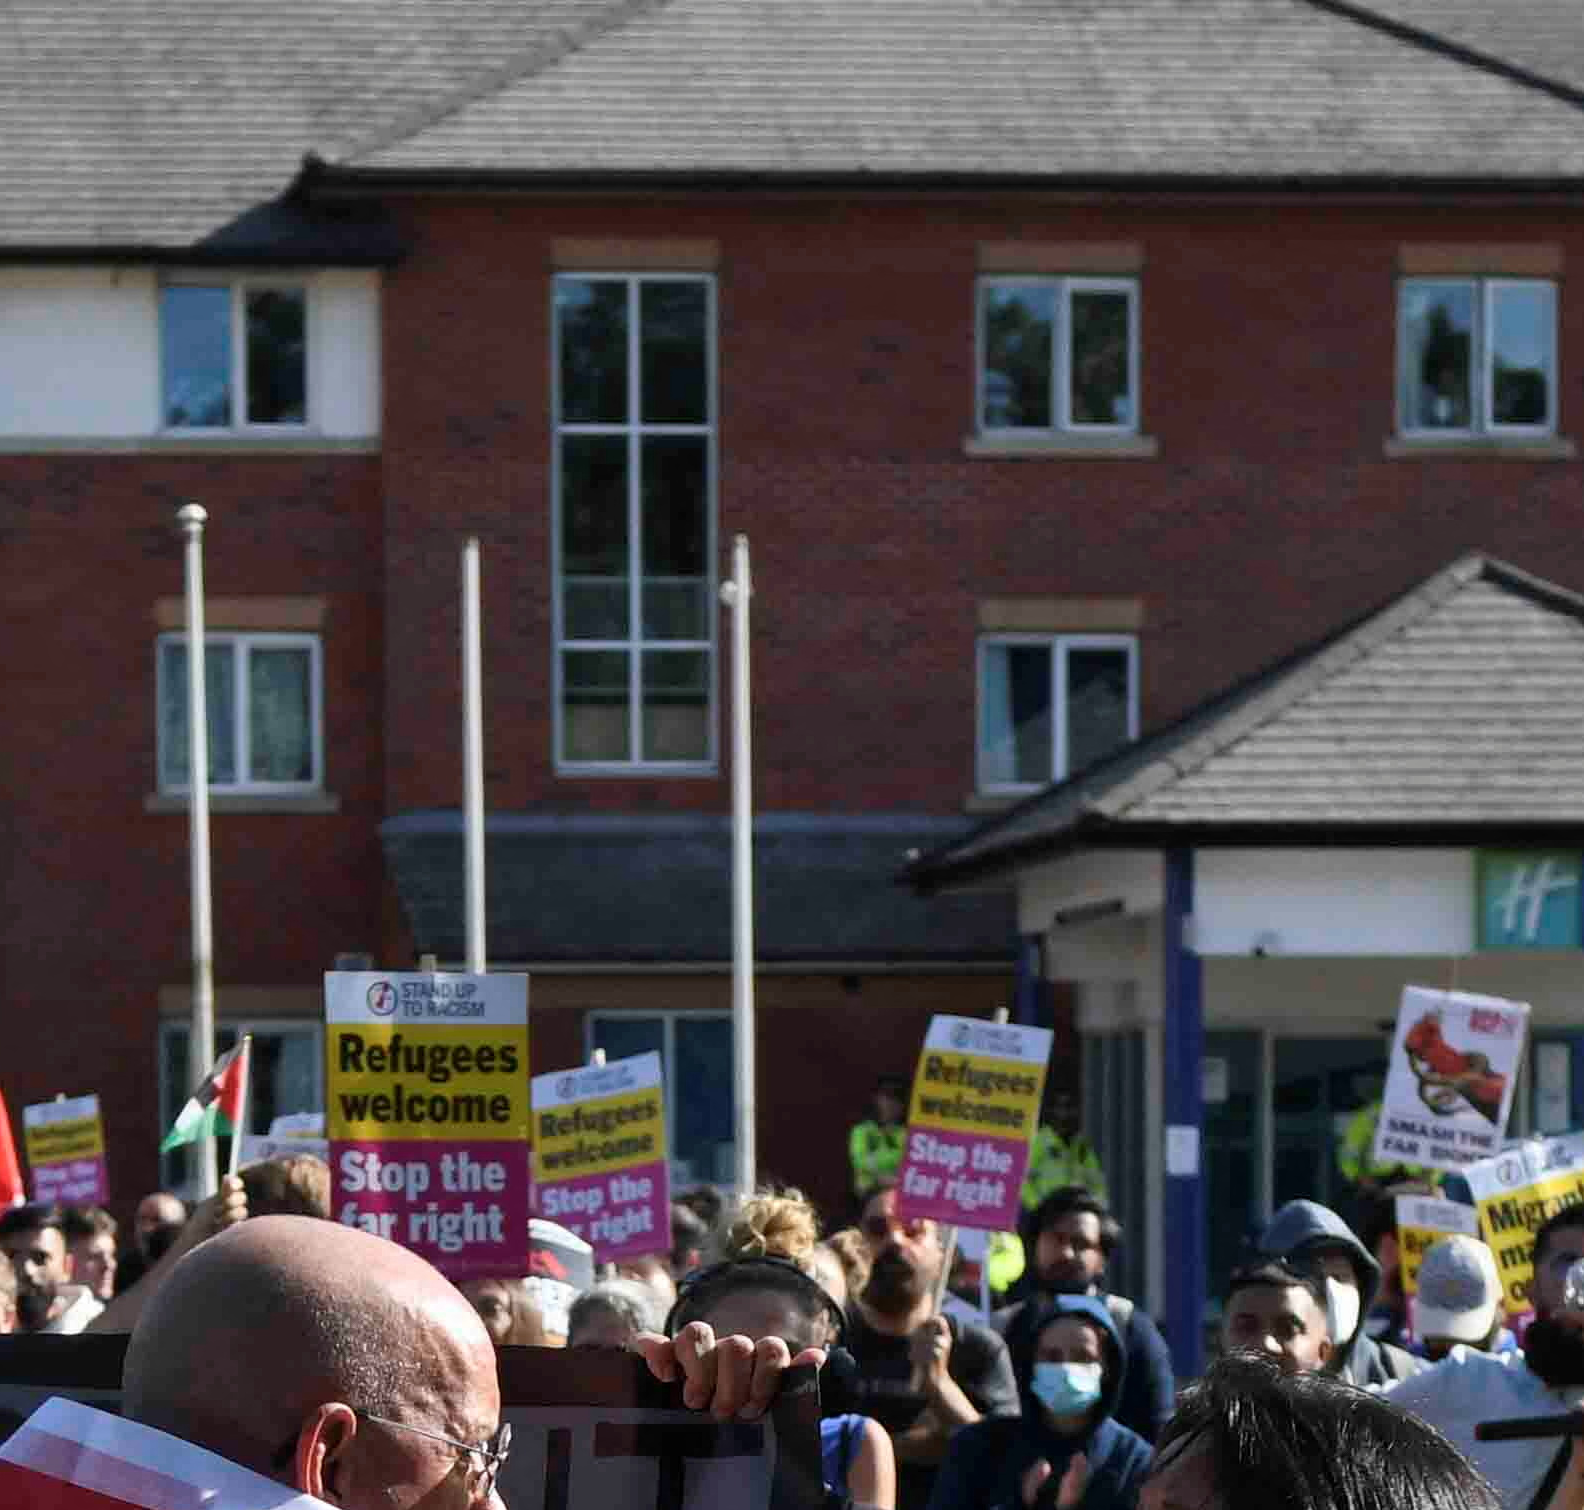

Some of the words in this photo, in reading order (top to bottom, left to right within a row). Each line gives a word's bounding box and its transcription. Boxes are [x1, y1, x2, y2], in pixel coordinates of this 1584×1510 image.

[401, 981, 452, 1000] STAND
[456, 983, 477, 1001] UP
[402, 1001, 424, 1016] TO
[430, 1000, 485, 1016] RACISM
[338, 1033, 519, 1083] Refugees
[927, 1055, 1037, 1096] Refugees
[338, 1083, 511, 1124] welcome
[541, 1100, 658, 1136] Refugees
[541, 1134, 655, 1169] welcome
[910, 1132, 966, 1173] Stop
[972, 1142, 1012, 1174] the
[340, 1150, 430, 1203] Stop
[440, 1153, 506, 1192] the
[541, 1186, 605, 1217] Stop
[609, 1176, 653, 1204] the
[904, 1166, 941, 1197] far
[943, 1173, 1006, 1210] right
[409, 1203, 505, 1252] right
[590, 1206, 655, 1246] right
